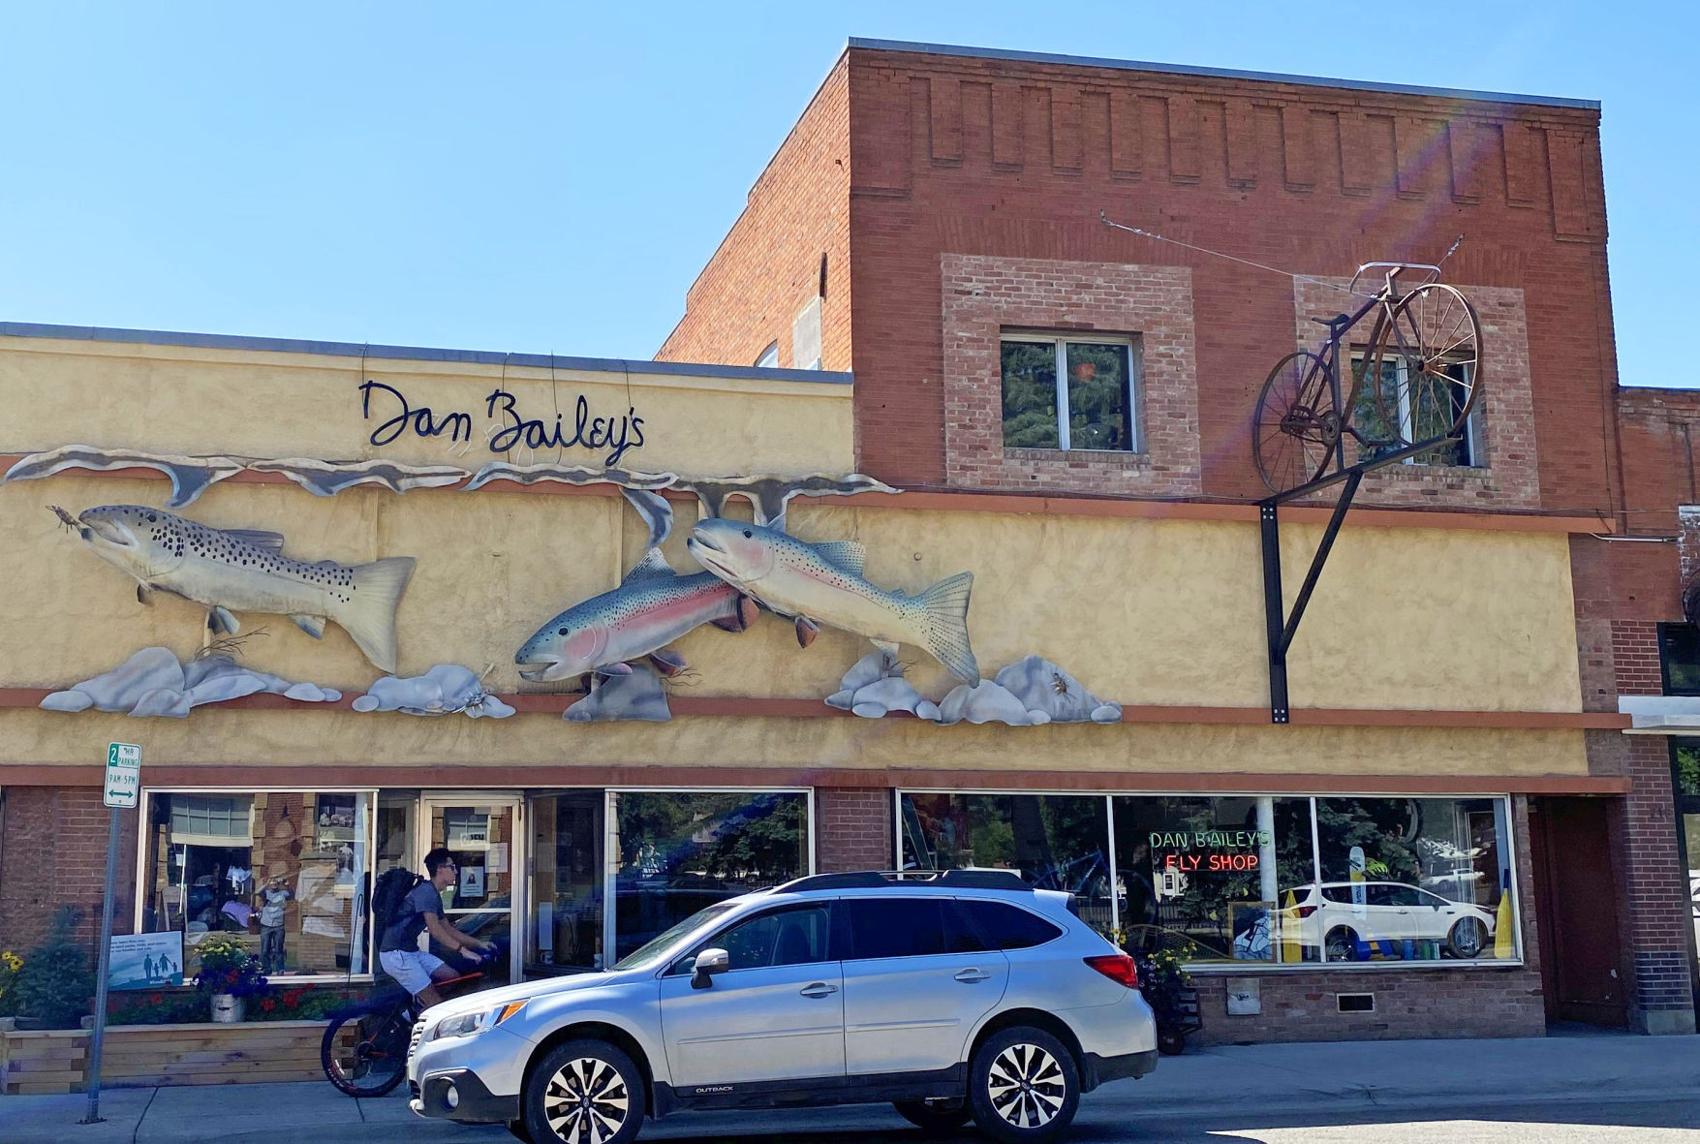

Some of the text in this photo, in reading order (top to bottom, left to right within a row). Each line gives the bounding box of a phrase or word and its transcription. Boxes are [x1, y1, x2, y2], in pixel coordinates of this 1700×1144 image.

[359, 380, 644, 467] Dan Bailey's
[110, 747, 117, 763] 2
[118, 757, 139, 767] PARKING
[1150, 831, 1271, 848] DAN BAILEY'S
[1165, 854, 1259, 871] FLY SHOP
